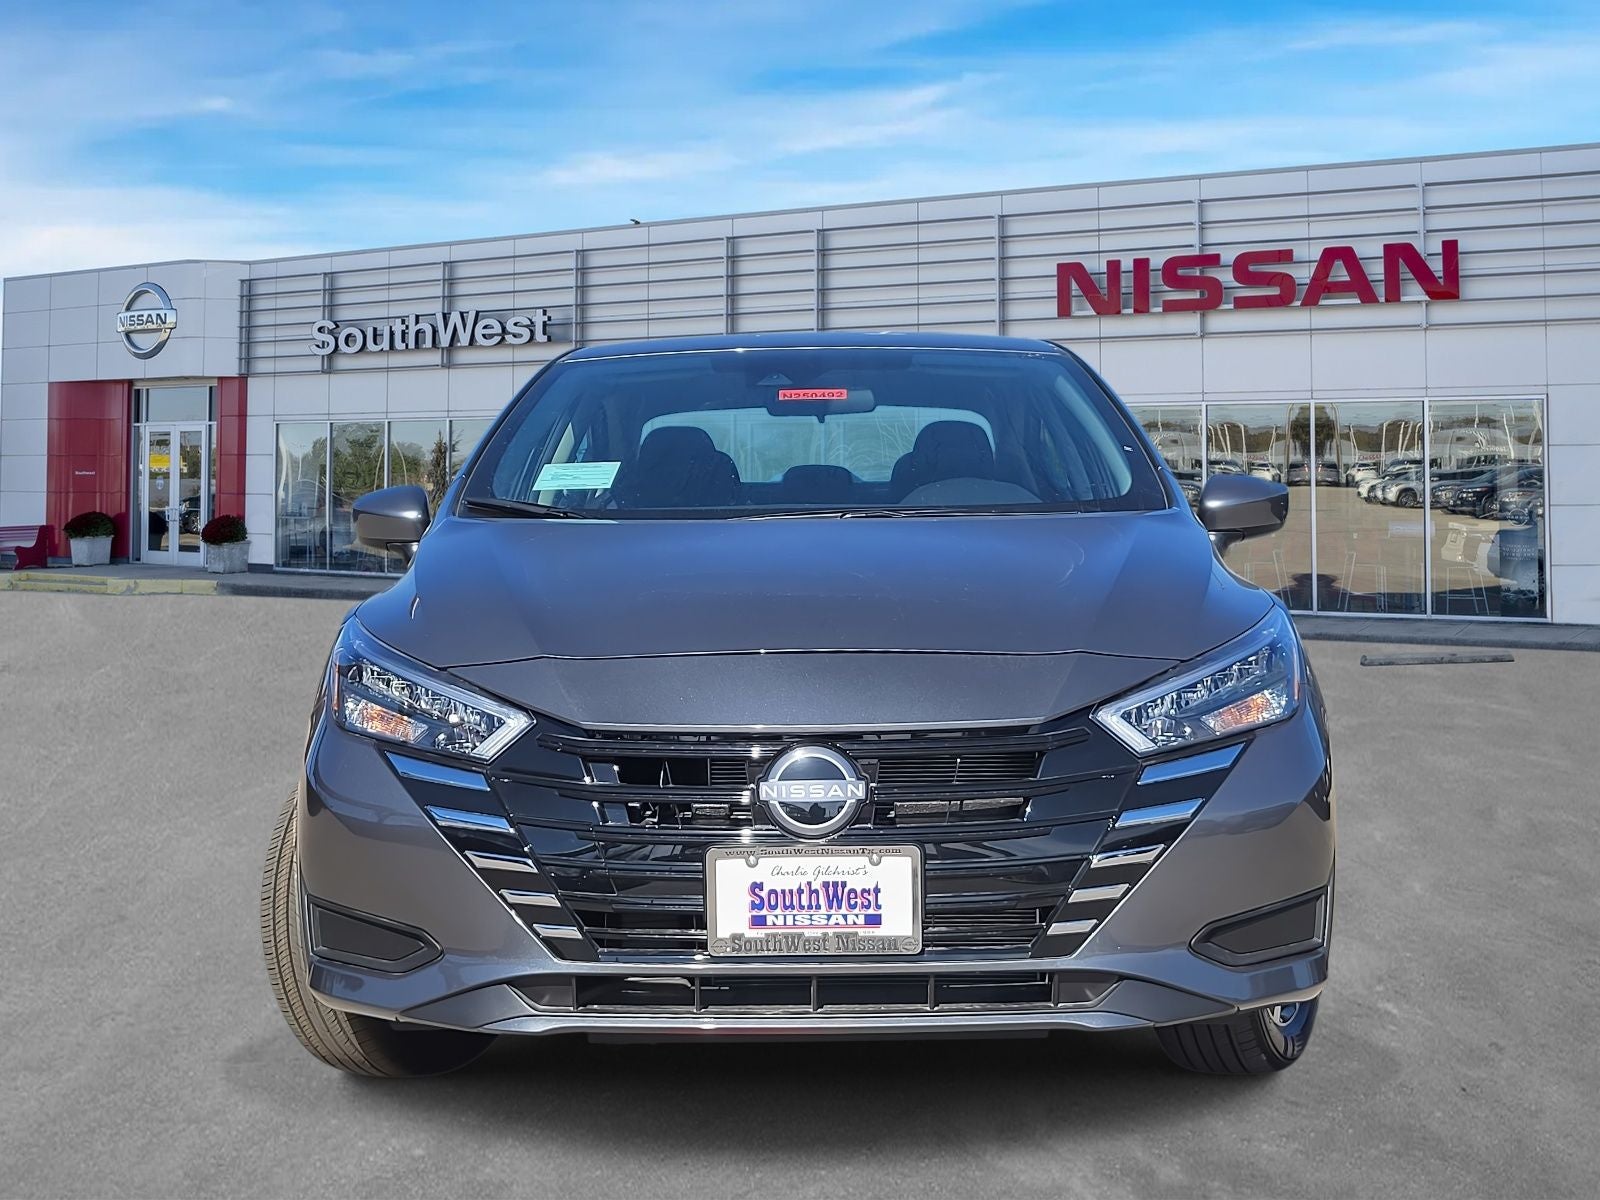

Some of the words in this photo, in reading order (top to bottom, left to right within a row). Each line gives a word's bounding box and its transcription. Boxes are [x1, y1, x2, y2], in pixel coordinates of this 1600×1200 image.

[1056, 239, 1460, 319] NISSAN
[118, 312, 168, 328] NISSAN
[309, 308, 552, 356] SouthWest
[761, 783, 864, 799] NISSAN
[748, 880, 882, 913] SouthWest
[765, 913, 866, 926] NISSAN
[730, 932, 830, 953] SouthWest
[835, 933, 900, 952] Nissan
